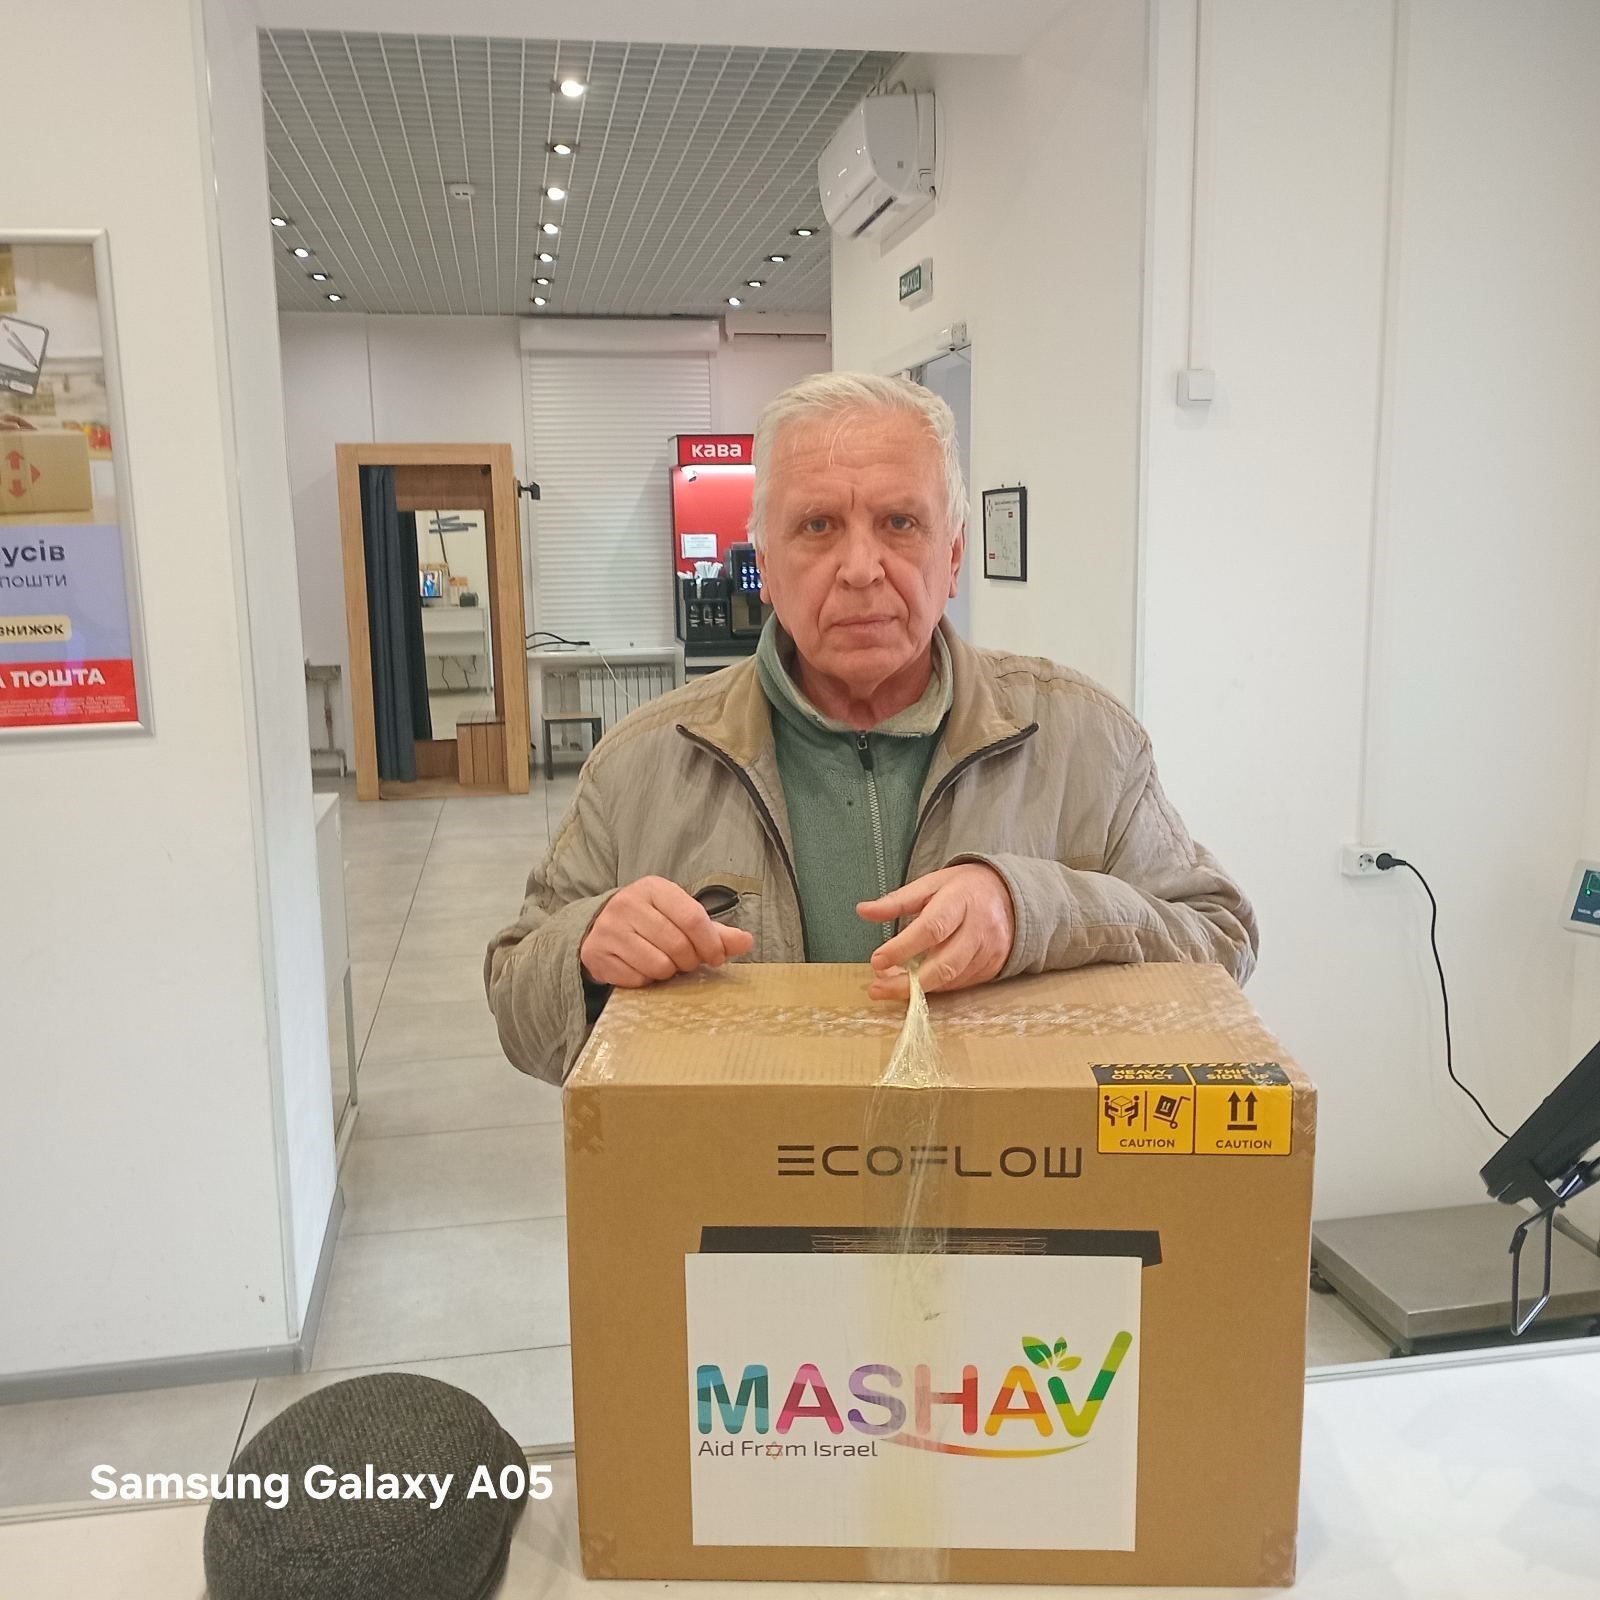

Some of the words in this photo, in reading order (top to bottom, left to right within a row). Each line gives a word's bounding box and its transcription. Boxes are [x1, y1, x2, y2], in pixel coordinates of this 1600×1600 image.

[1, 539, 66, 568] усів
[10, 668, 106, 688] ПОШТА
[1119, 1138, 1175, 1148] CAUTION
[1215, 1140, 1272, 1149] CAUTION
[777, 1145, 1082, 1178] ECOFLOW
[696, 1331, 1133, 1438] MASHAV
[698, 1441, 733, 1456] Aid
[814, 1441, 878, 1457] Israel
